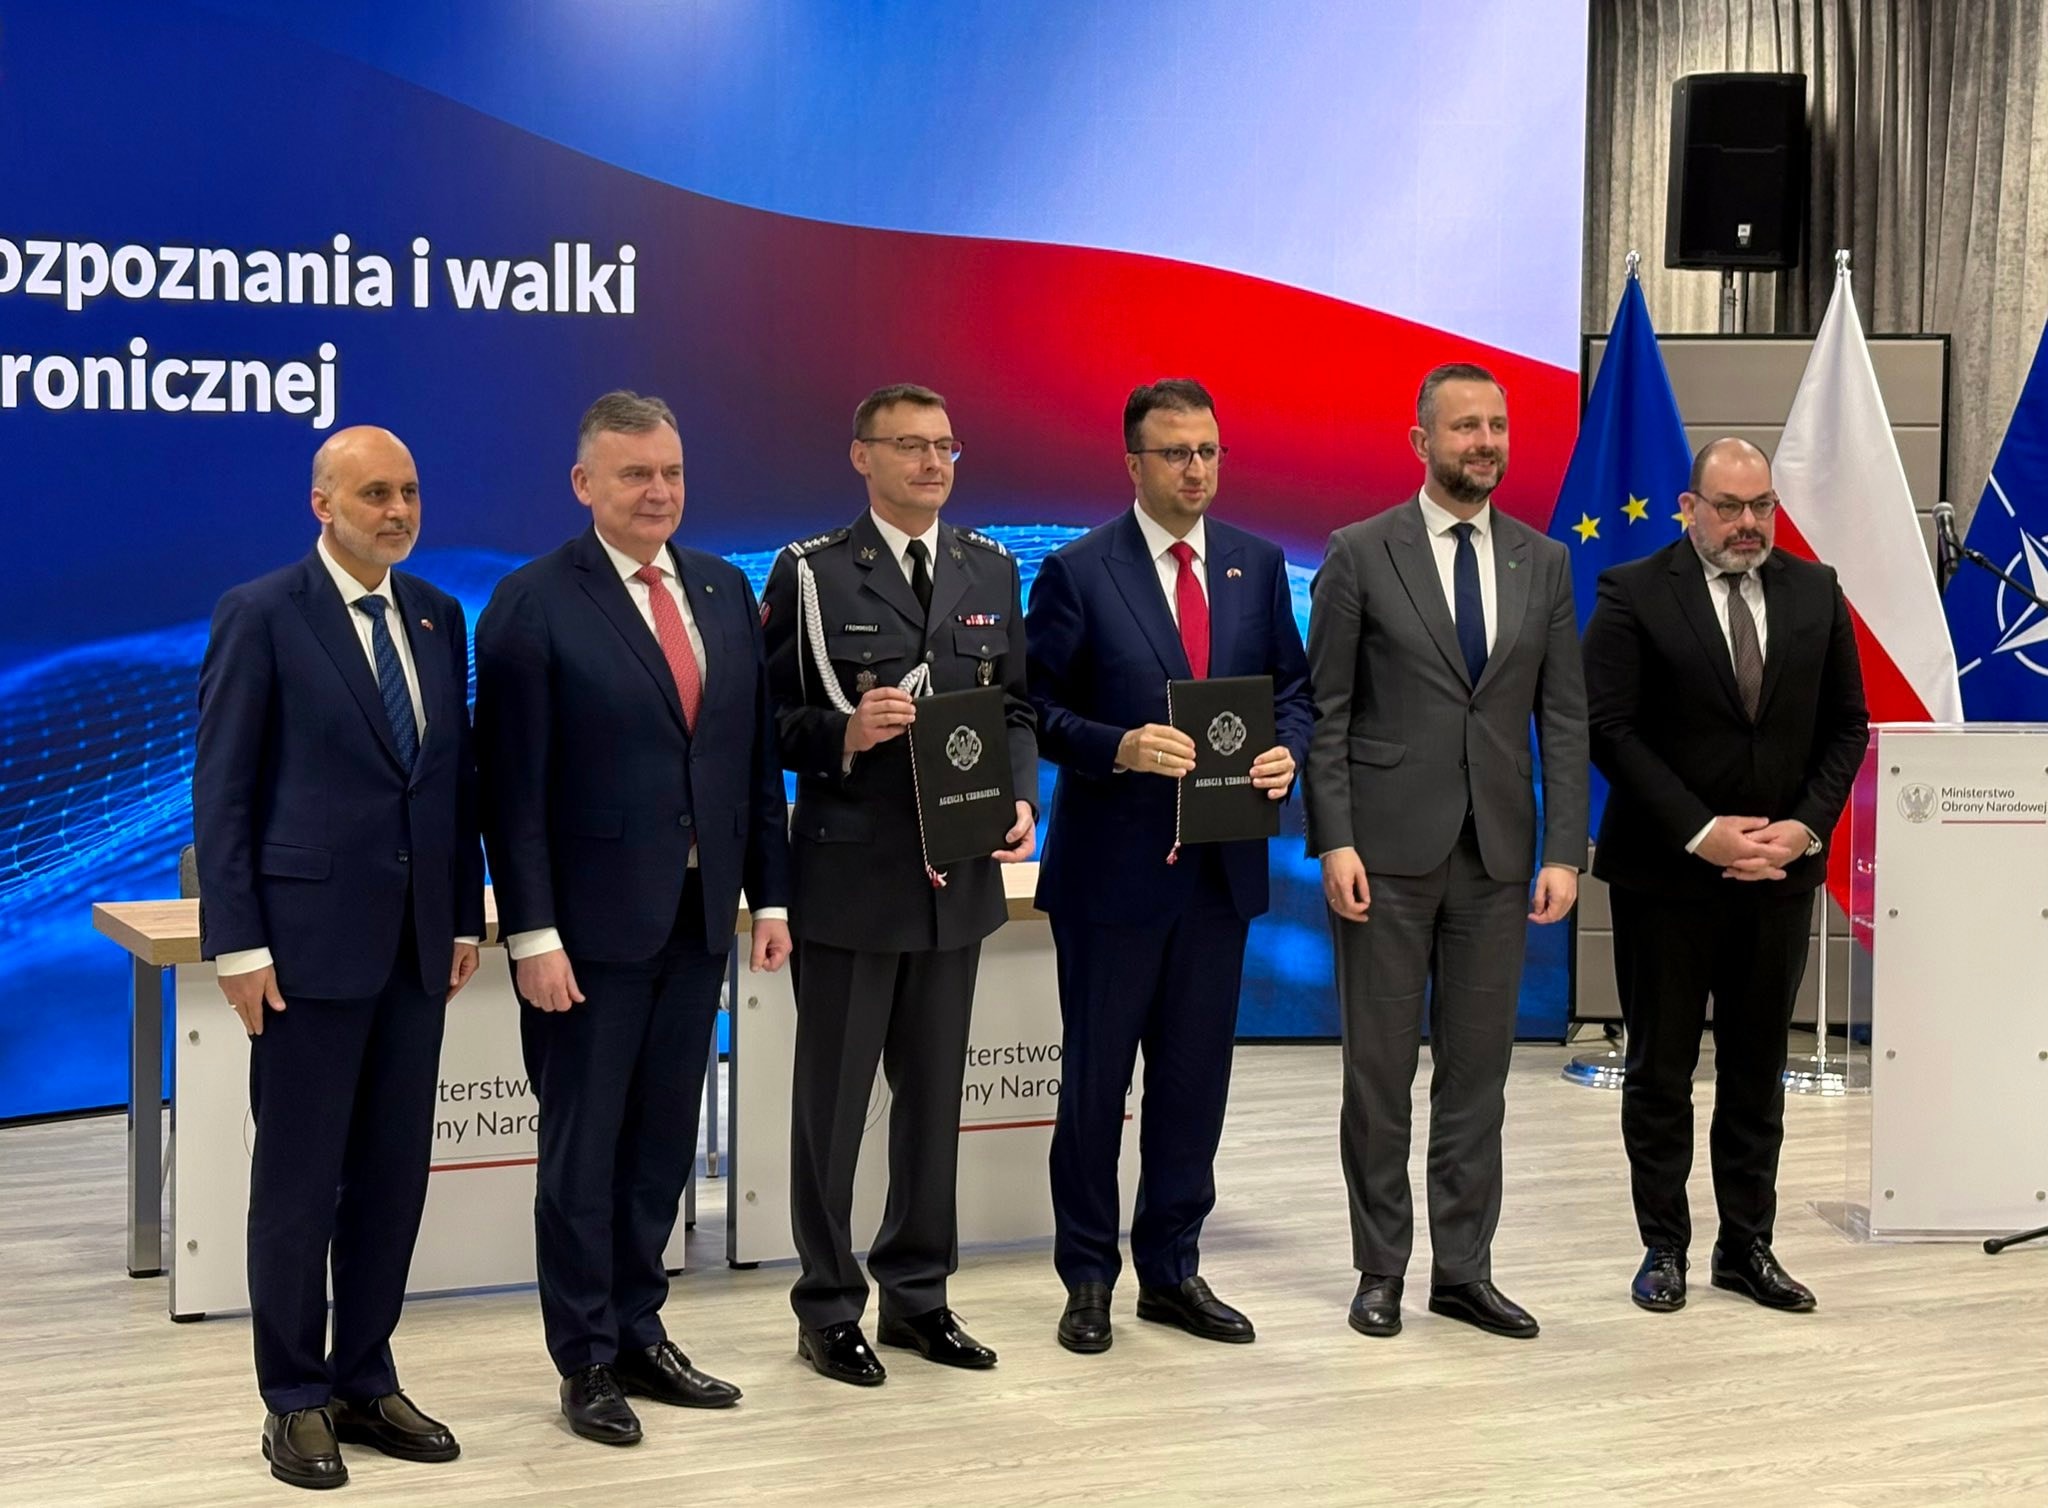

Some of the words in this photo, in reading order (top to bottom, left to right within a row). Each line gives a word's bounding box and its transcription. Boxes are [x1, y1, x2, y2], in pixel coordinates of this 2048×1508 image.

[412, 236, 431, 308] i
[445, 241, 637, 314] walki
[1, 336, 337, 429] ronicznej
[1941, 786, 2015, 798] Ministerstwo
[1941, 800, 1984, 814] Obrony
[1986, 800, 2047, 814] Narodowej
[961, 1082, 994, 1106] ny
